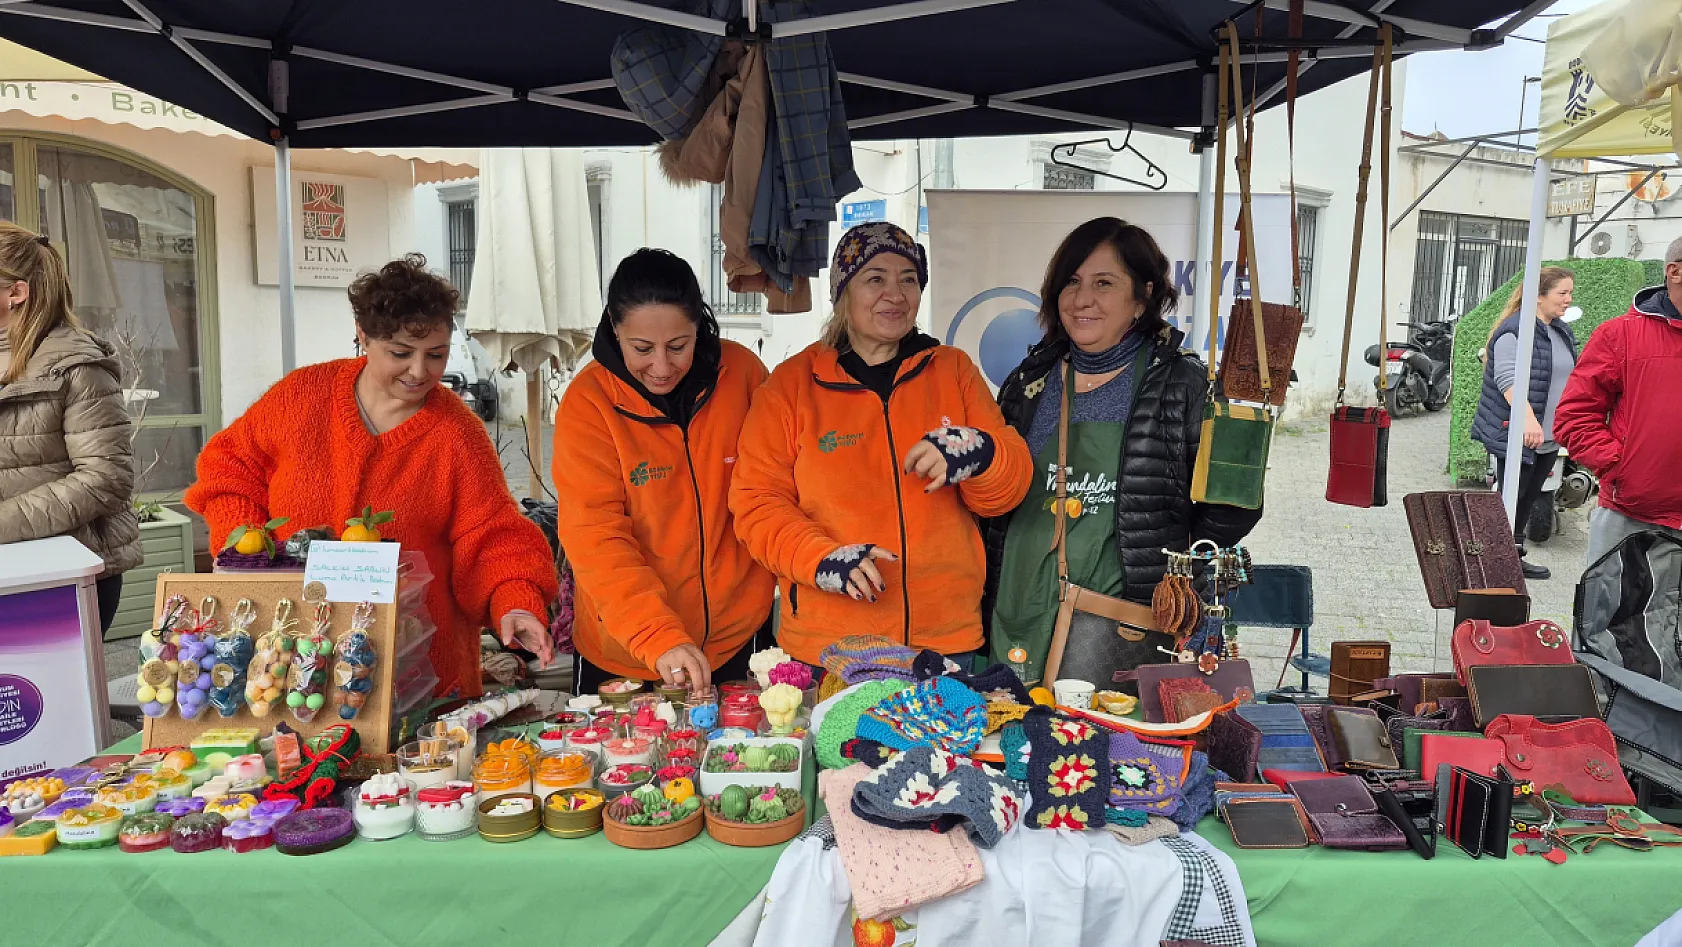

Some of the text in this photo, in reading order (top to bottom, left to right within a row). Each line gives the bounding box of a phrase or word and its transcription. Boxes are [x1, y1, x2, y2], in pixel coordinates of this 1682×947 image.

[111, 92, 206, 120] Bake
[304, 246, 348, 262] ETNA
[2, 760, 47, 778] değilsin!
